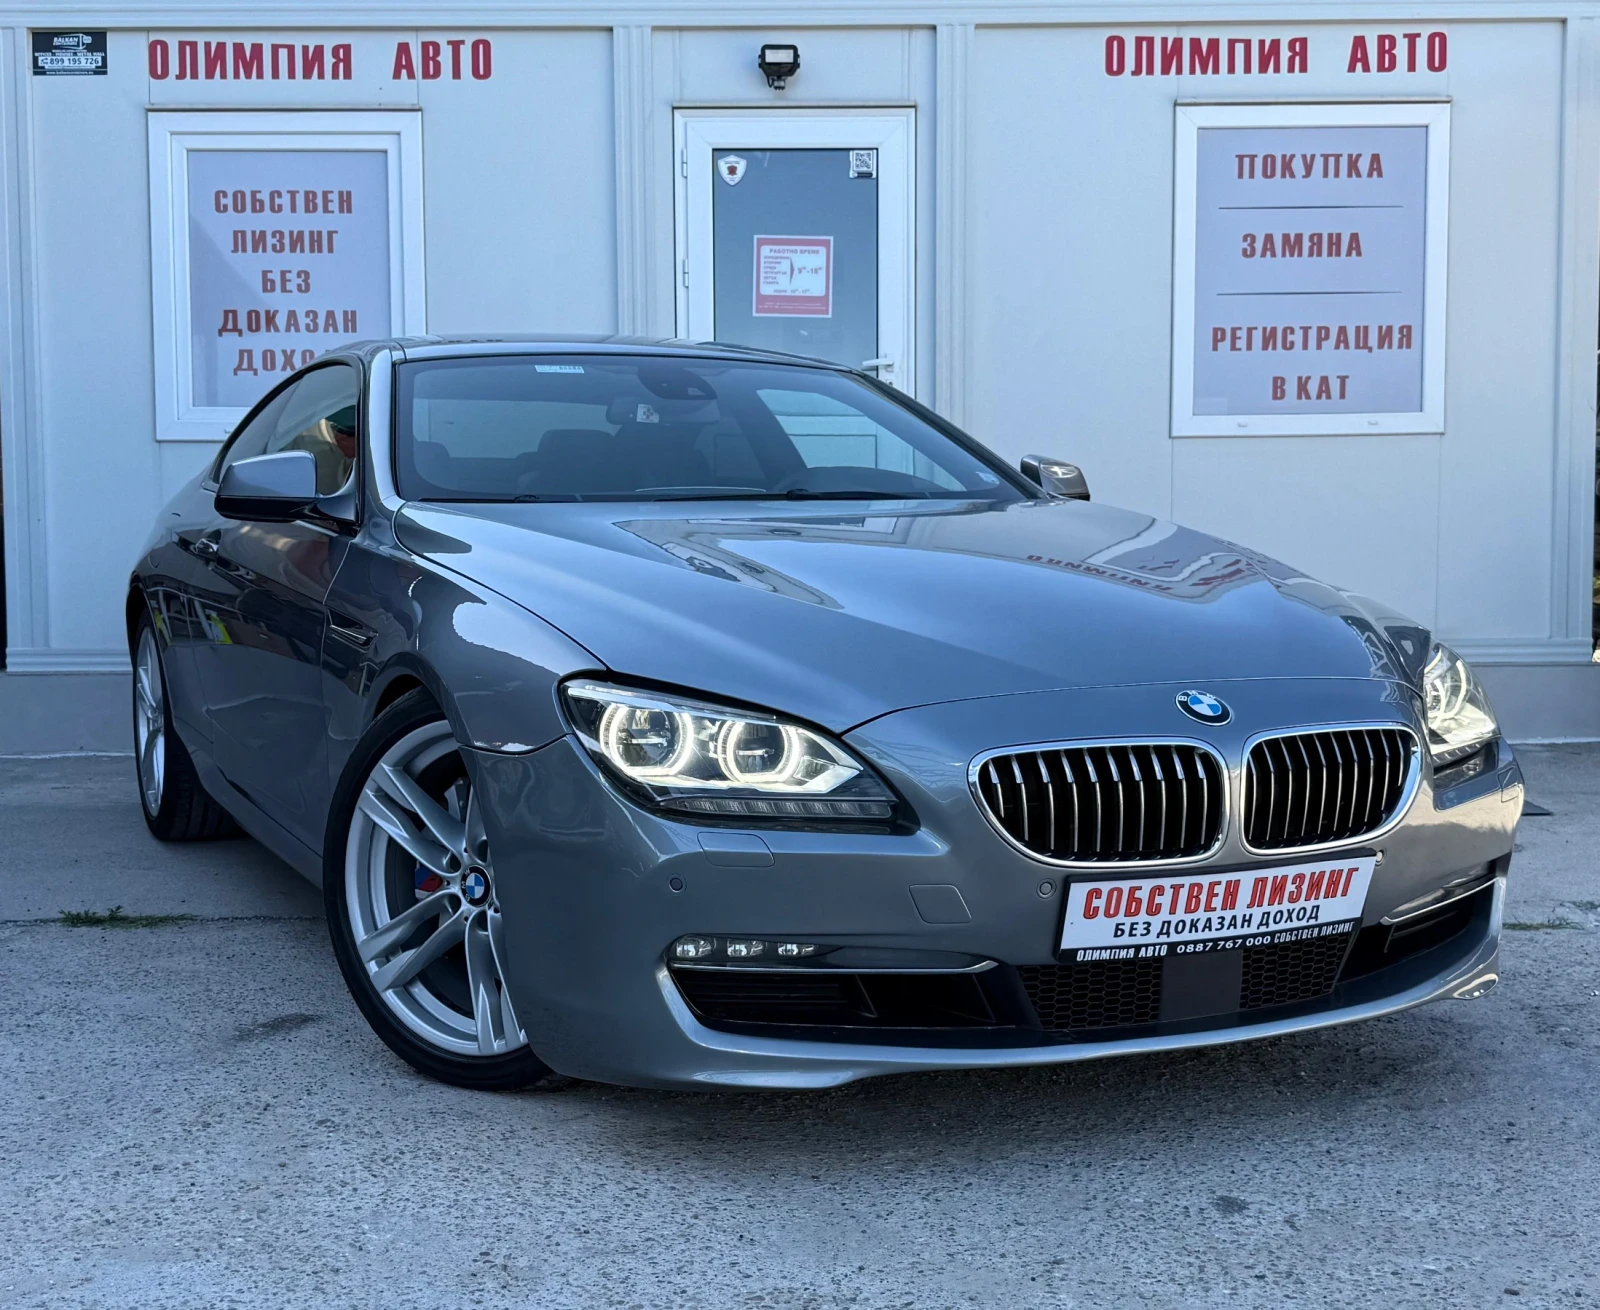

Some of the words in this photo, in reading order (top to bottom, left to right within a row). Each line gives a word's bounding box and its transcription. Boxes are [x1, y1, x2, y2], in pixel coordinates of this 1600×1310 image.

[49, 57, 65, 65] 899
[68, 57, 82, 65] 195
[84, 57, 100, 65] 726
[148, 39, 352, 81] ОЛИМПИЯ
[392, 38, 492, 80] АВТО
[1105, 35, 1308, 76] ОЛИМПИЯ
[1347, 31, 1447, 73] АВТО
[1235, 153, 1383, 179] ПОКУПКА
[214, 190, 352, 214] СОБСТВЕН
[231, 230, 338, 254] ЛИЗИНГ
[1241, 232, 1362, 258] ЗАМЯНА
[261, 270, 311, 293] БЕЗ
[218, 309, 358, 336] ДОКАЗАН
[1211, 324, 1413, 353] РЕГИСТРАЦИЯ
[233, 349, 331, 376] ДОХО
[1272, 376, 1286, 400] В
[1296, 375, 1350, 400] КАТ
[1083, 879, 1241, 920] СОБСТВЕН
[1246, 867, 1360, 909] ЛИЗИНГ
[1113, 921, 1152, 938] БЕЗ
[1156, 913, 1253, 939] ДОКАЗАН
[1256, 904, 1321, 930] ДОХОД
[1076, 948, 1135, 962] ОЛИМПИЯ
[1138, 944, 1168, 958] АВТО
[1176, 941, 1213, 954] 0887
[1216, 939, 1243, 950] 767
[1245, 935, 1272, 947] 000
[1274, 927, 1319, 944] СОБСТВЕН
[1320, 921, 1355, 937] ЛИЗИНГ
